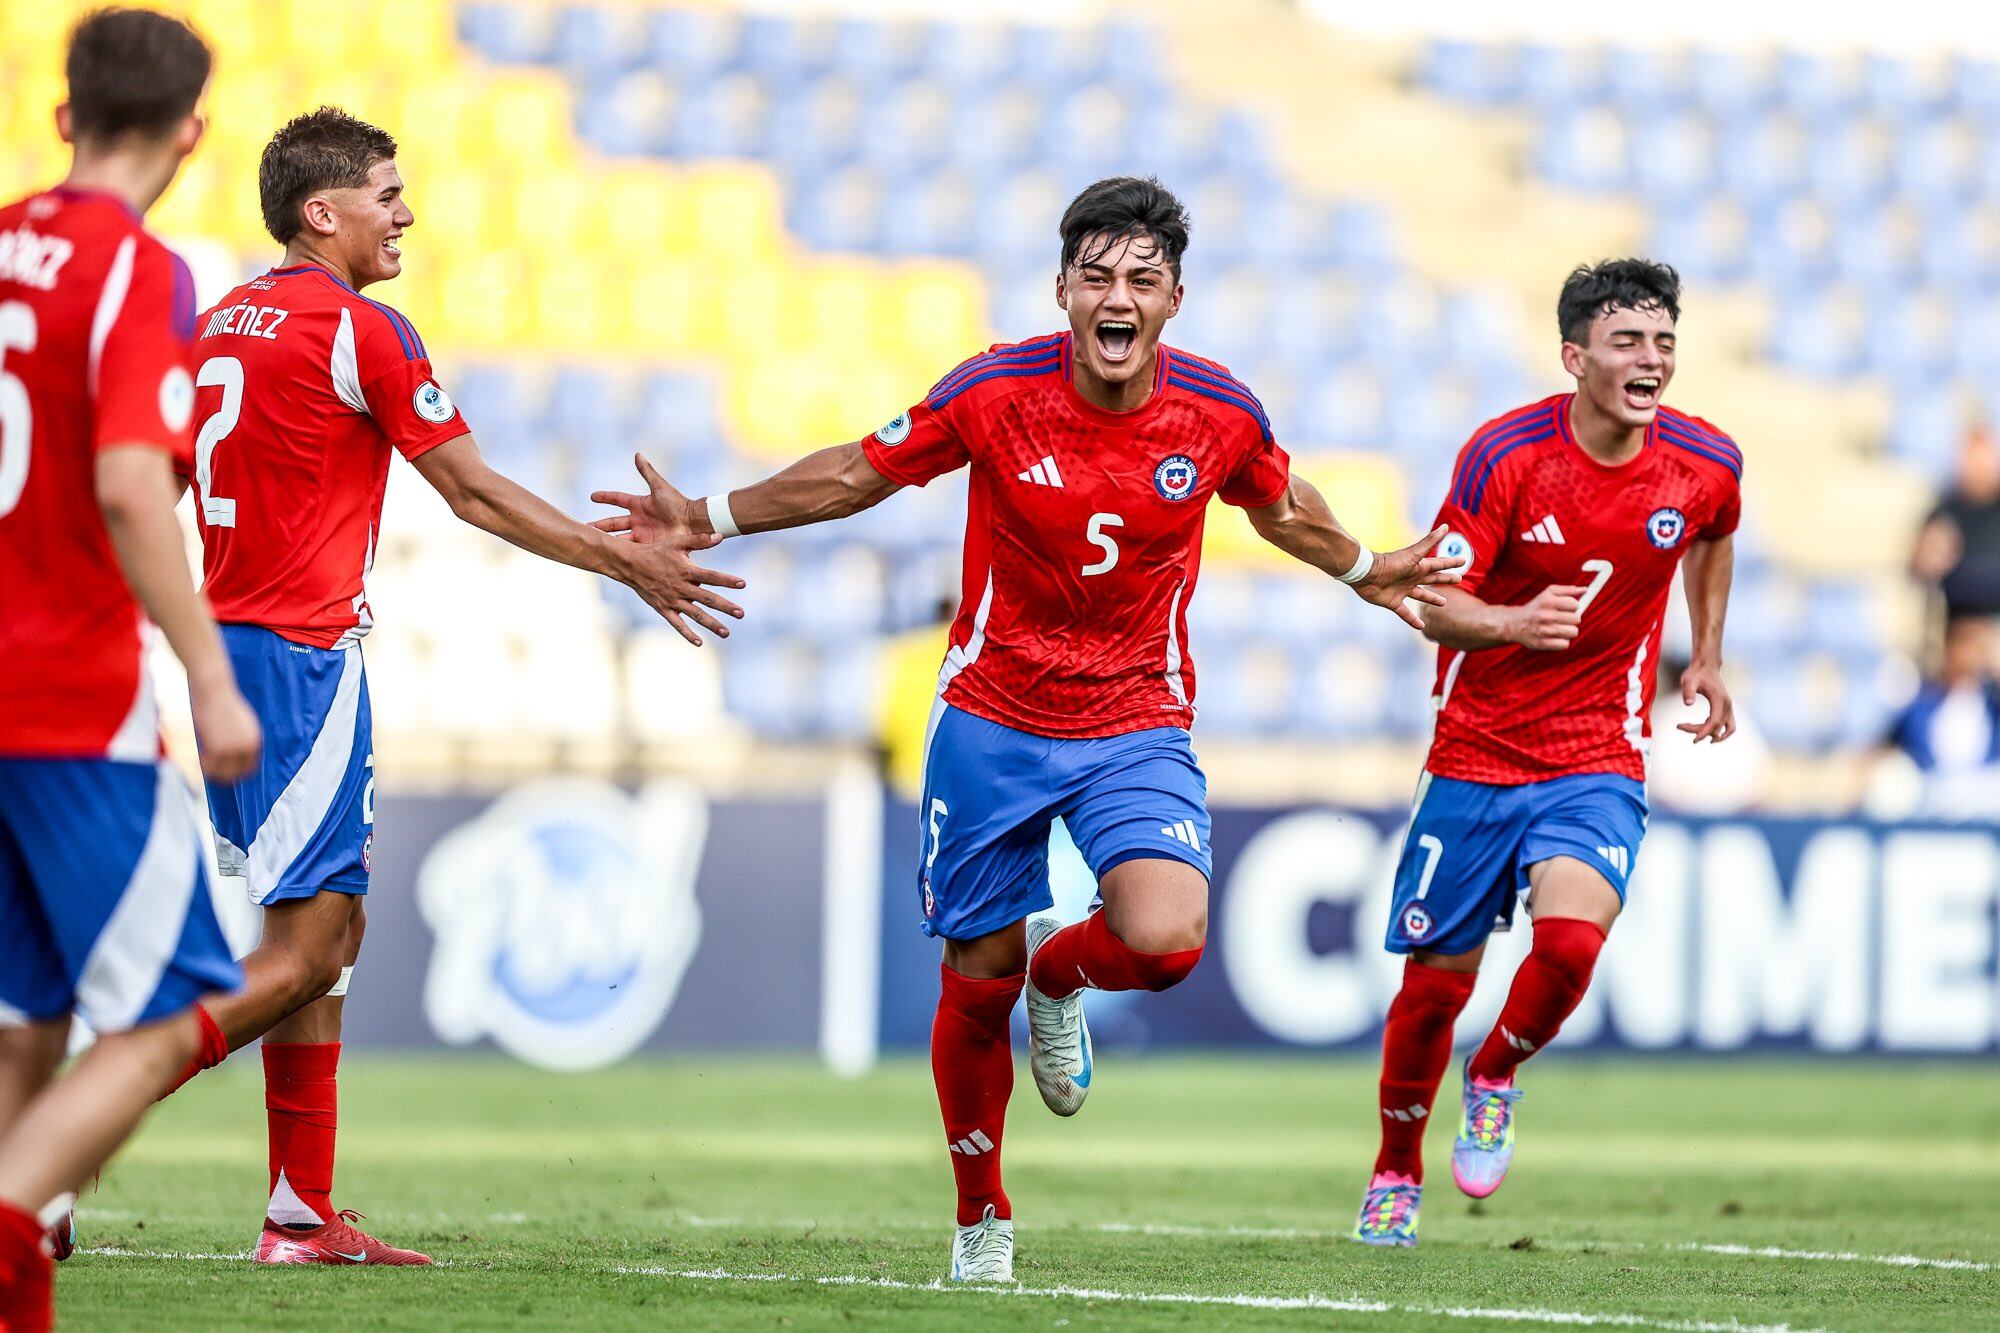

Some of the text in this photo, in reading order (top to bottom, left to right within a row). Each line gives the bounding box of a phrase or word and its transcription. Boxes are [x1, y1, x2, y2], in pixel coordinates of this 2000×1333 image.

[195, 356, 245, 528] 2
[1082, 512, 1124, 577] 5
[1575, 559, 1614, 619] 7
[926, 797, 949, 868] 5
[1416, 833, 1444, 900] 7
